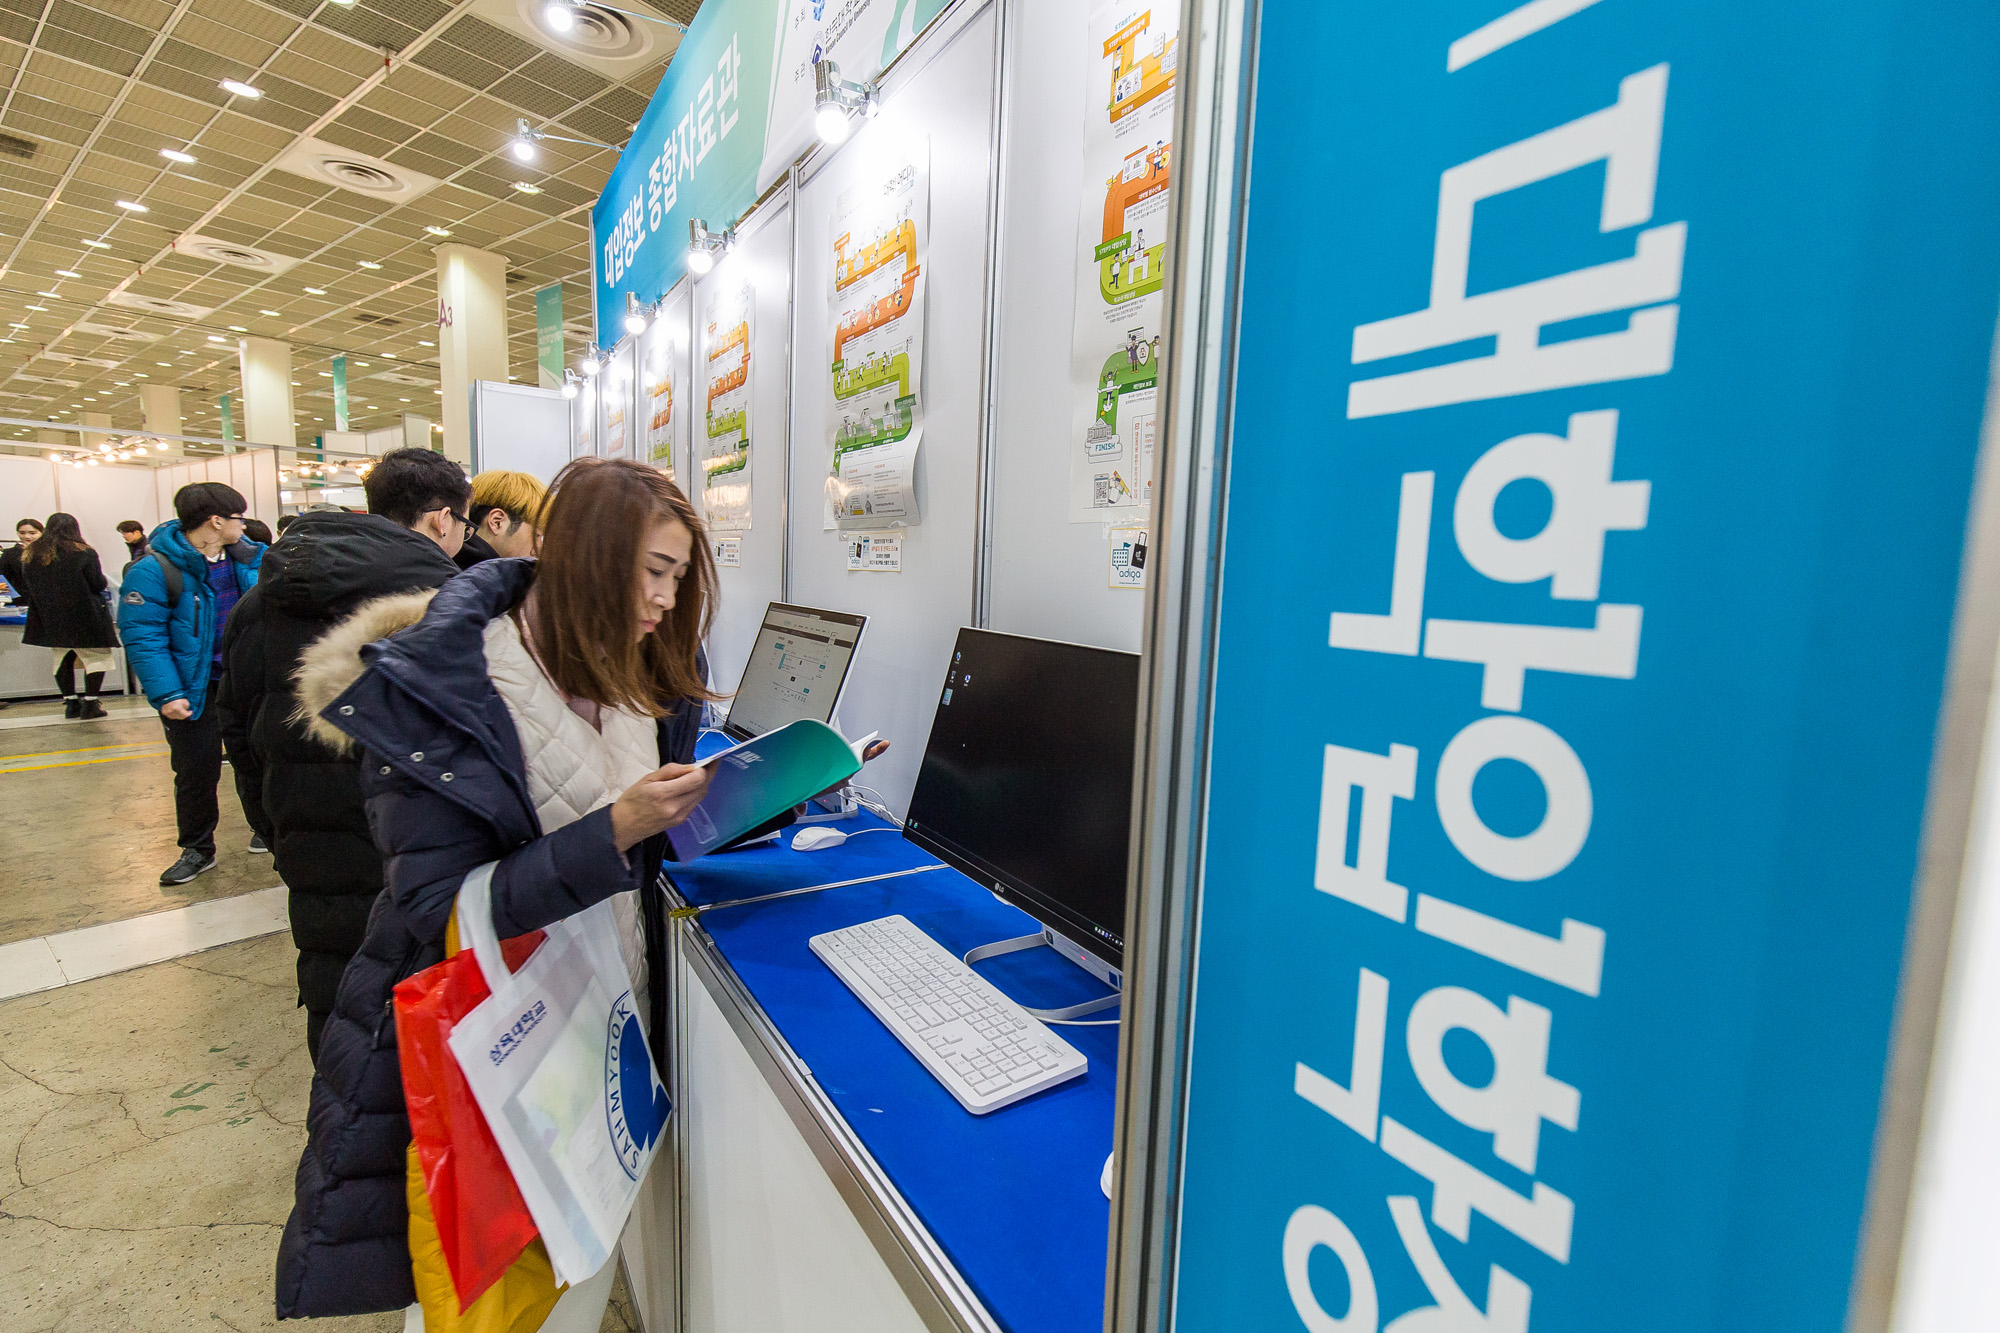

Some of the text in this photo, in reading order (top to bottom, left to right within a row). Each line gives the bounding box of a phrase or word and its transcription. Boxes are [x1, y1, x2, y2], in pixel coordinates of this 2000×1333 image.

[1114, 15, 1132, 32] START
[604, 31, 742, 289] 대입정보 종합자료관
[438, 298, 453, 329] A3
[1095, 443, 1116, 452] FINISH
[1118, 568, 1141, 582] adiga
[489, 1000, 547, 1064] 삼육대학교
[609, 1002, 640, 1169] SAHMYOOK
